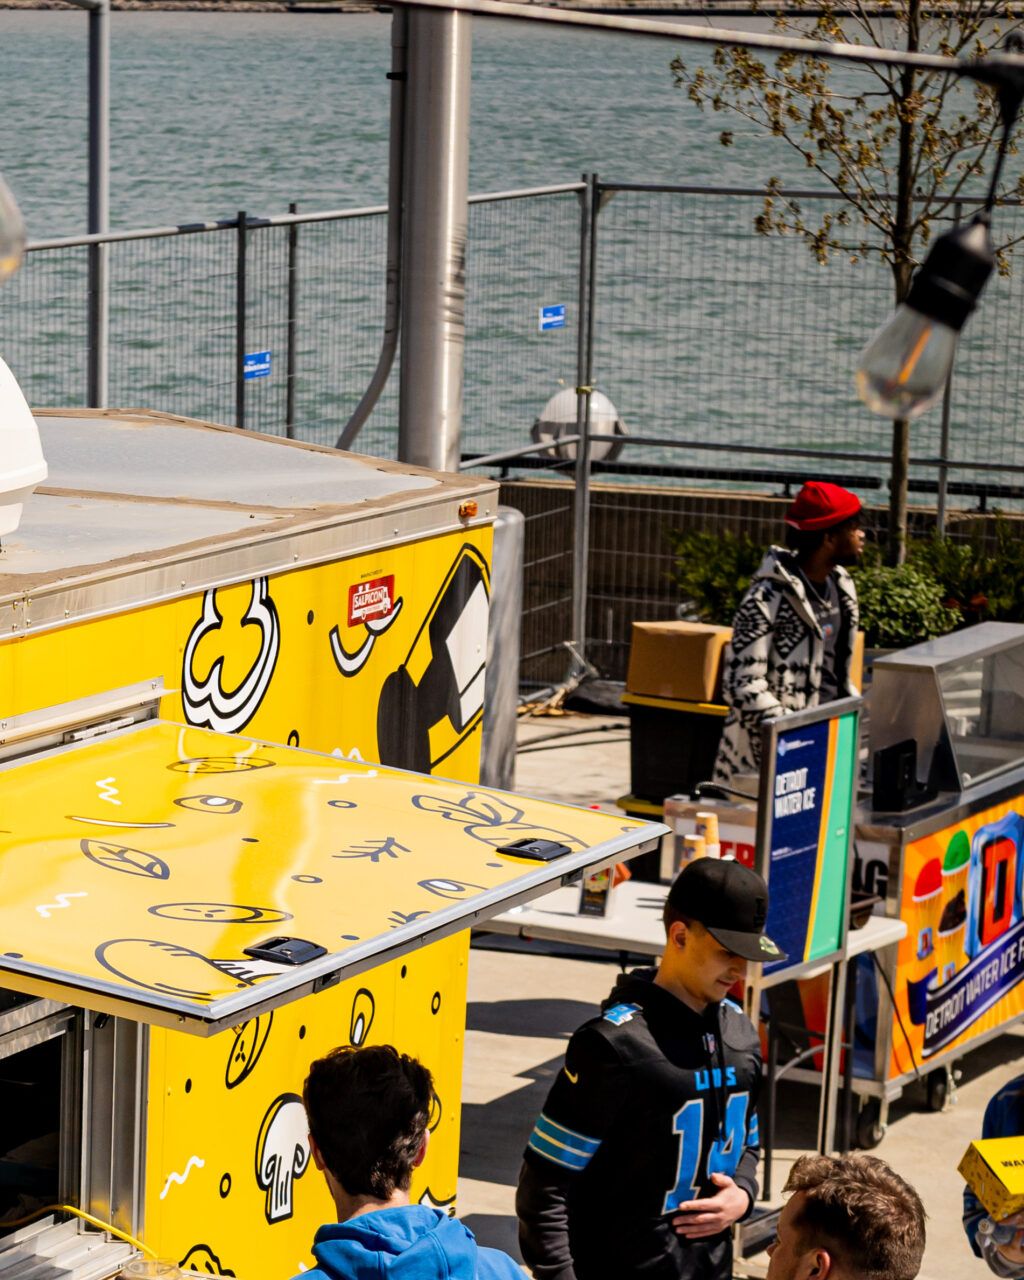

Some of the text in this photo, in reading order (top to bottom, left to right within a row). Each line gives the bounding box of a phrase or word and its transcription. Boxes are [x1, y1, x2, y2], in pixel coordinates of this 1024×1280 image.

[354, 589, 384, 609] SALPICON
[775, 767, 809, 797] DETROIT
[774, 787, 816, 819] WATER ICE
[925, 986, 967, 1039] DETROIT
[965, 958, 1000, 1006] WATER
[999, 941, 1018, 978] ICE
[661, 1090, 750, 1216] 14
